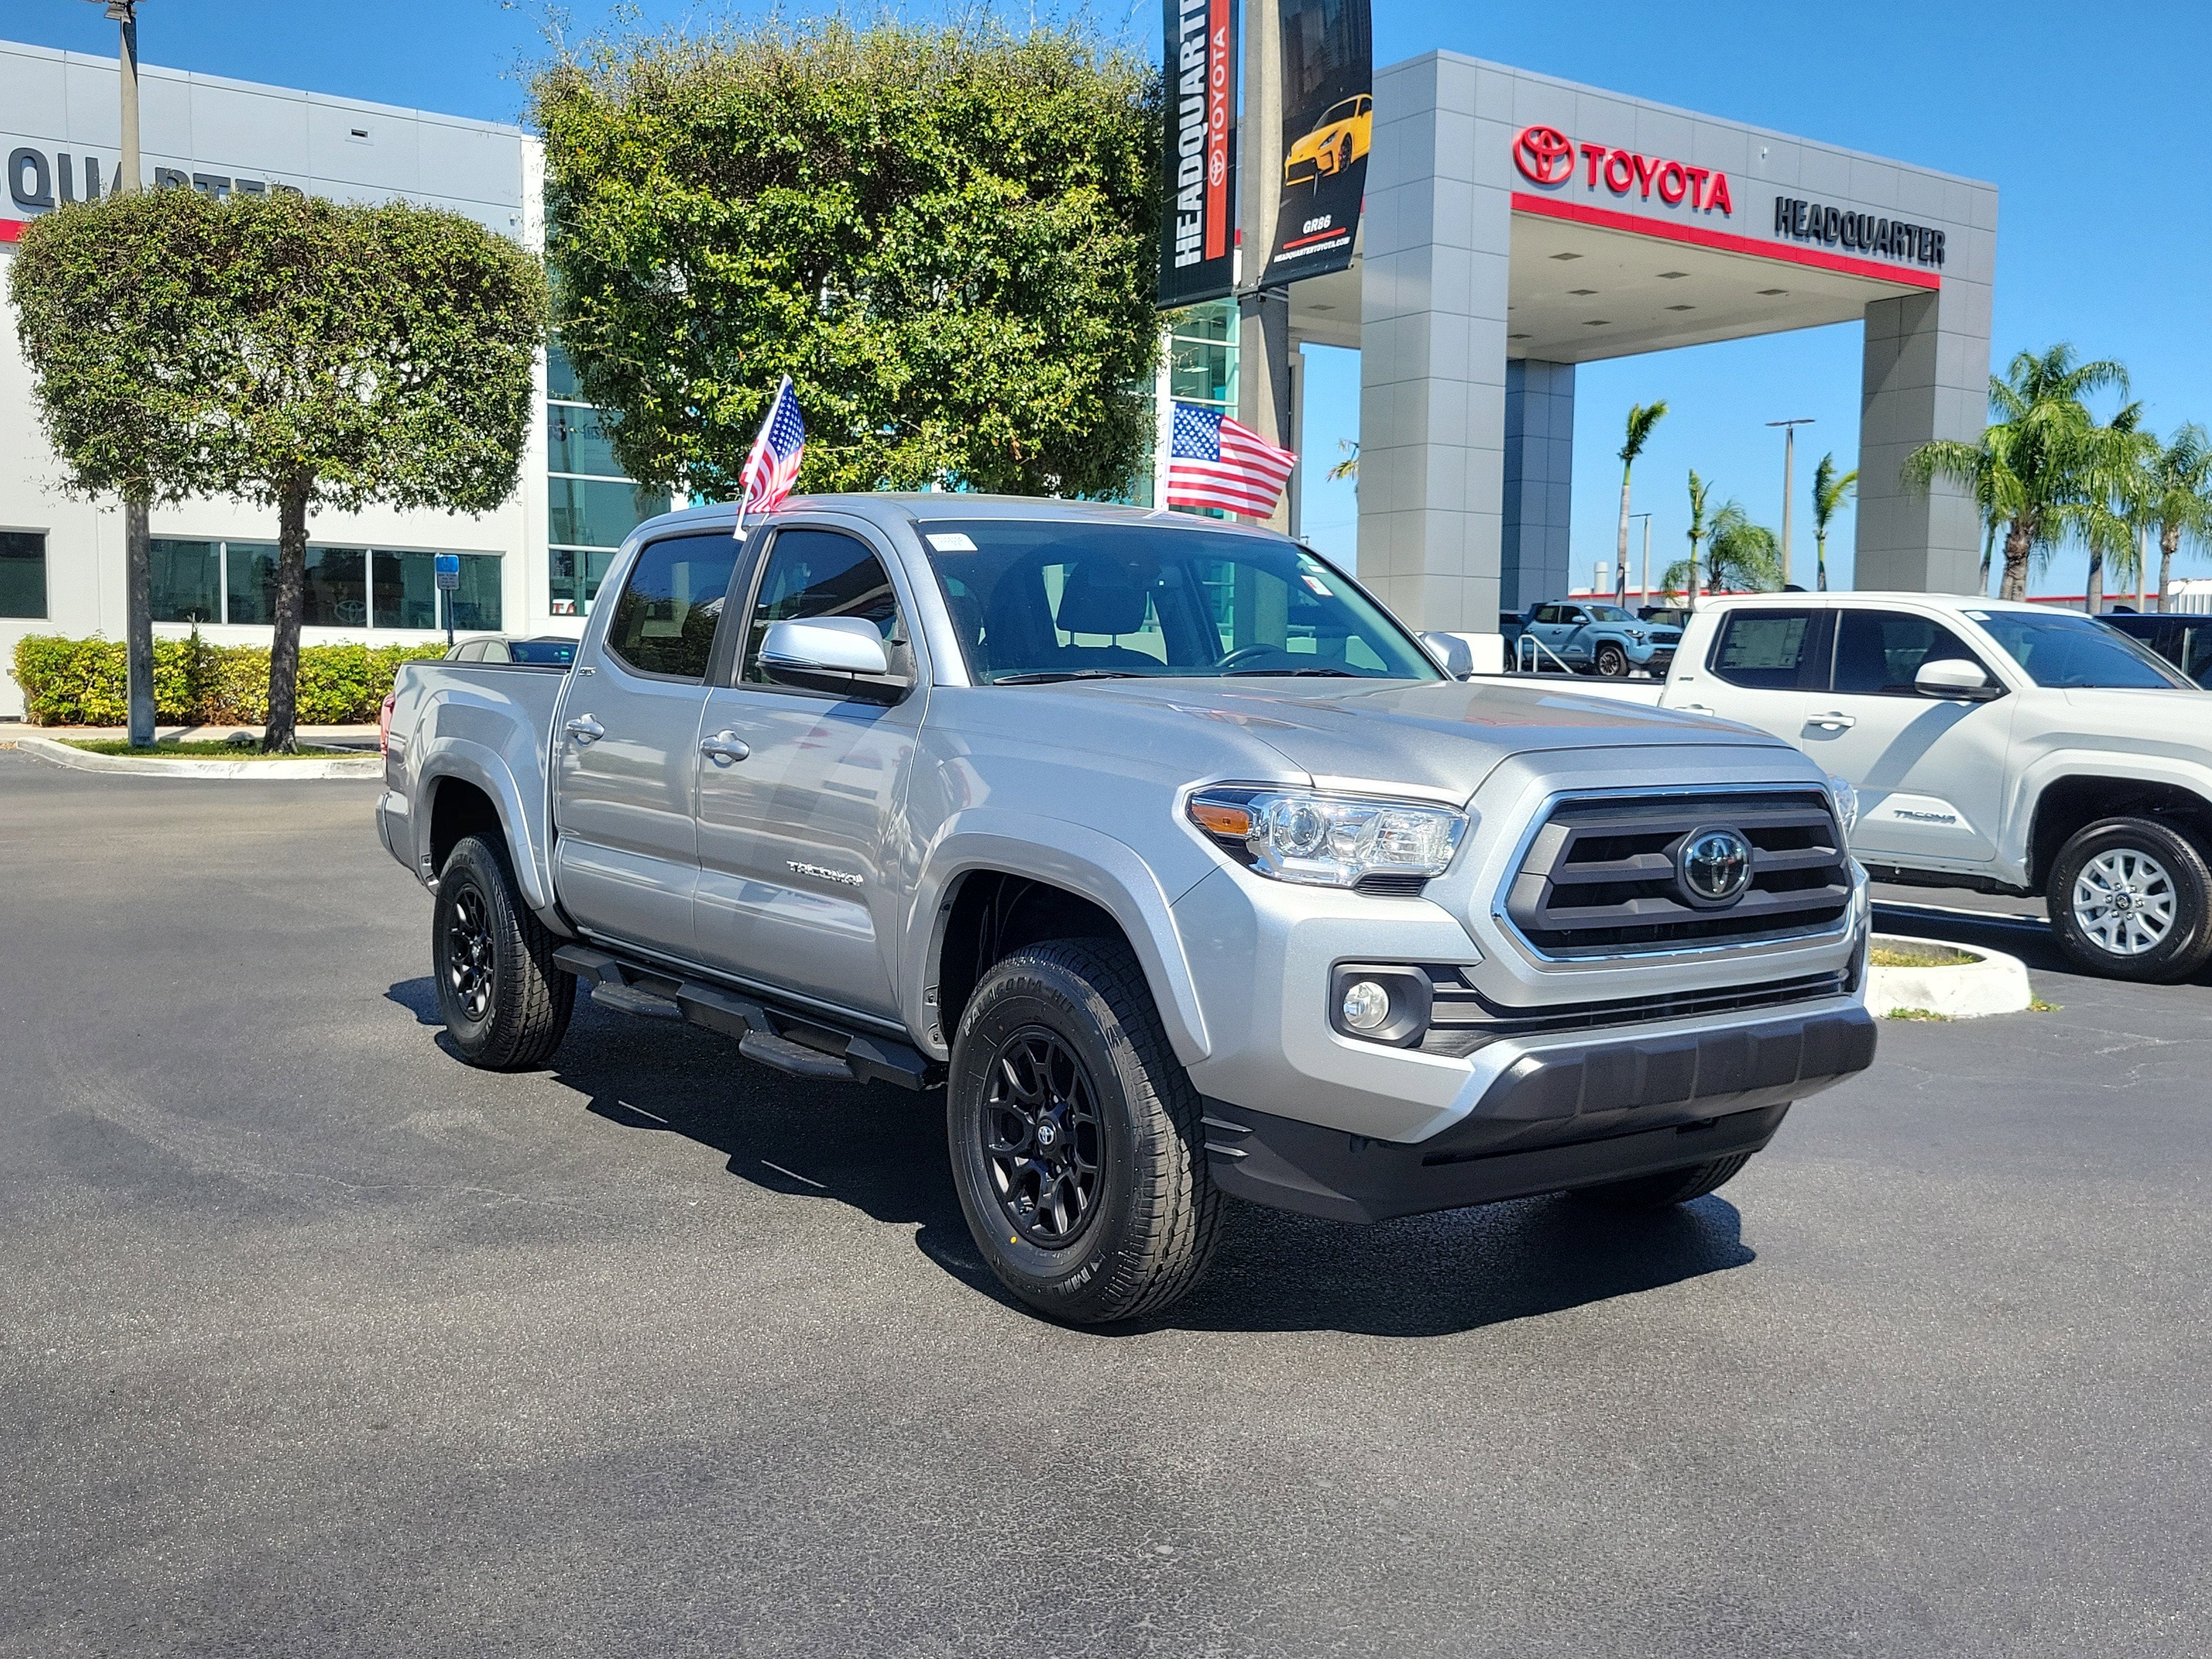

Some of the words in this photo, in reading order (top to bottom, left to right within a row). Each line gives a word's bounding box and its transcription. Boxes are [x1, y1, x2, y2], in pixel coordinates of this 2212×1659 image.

[1212, 26, 1225, 142] TOYOTA
[1581, 143, 1733, 213] TOYOTA
[1302, 214, 1332, 234] GR86
[1775, 196, 1945, 263] HEADQUARTER
[786, 860, 864, 887] TACOMA
